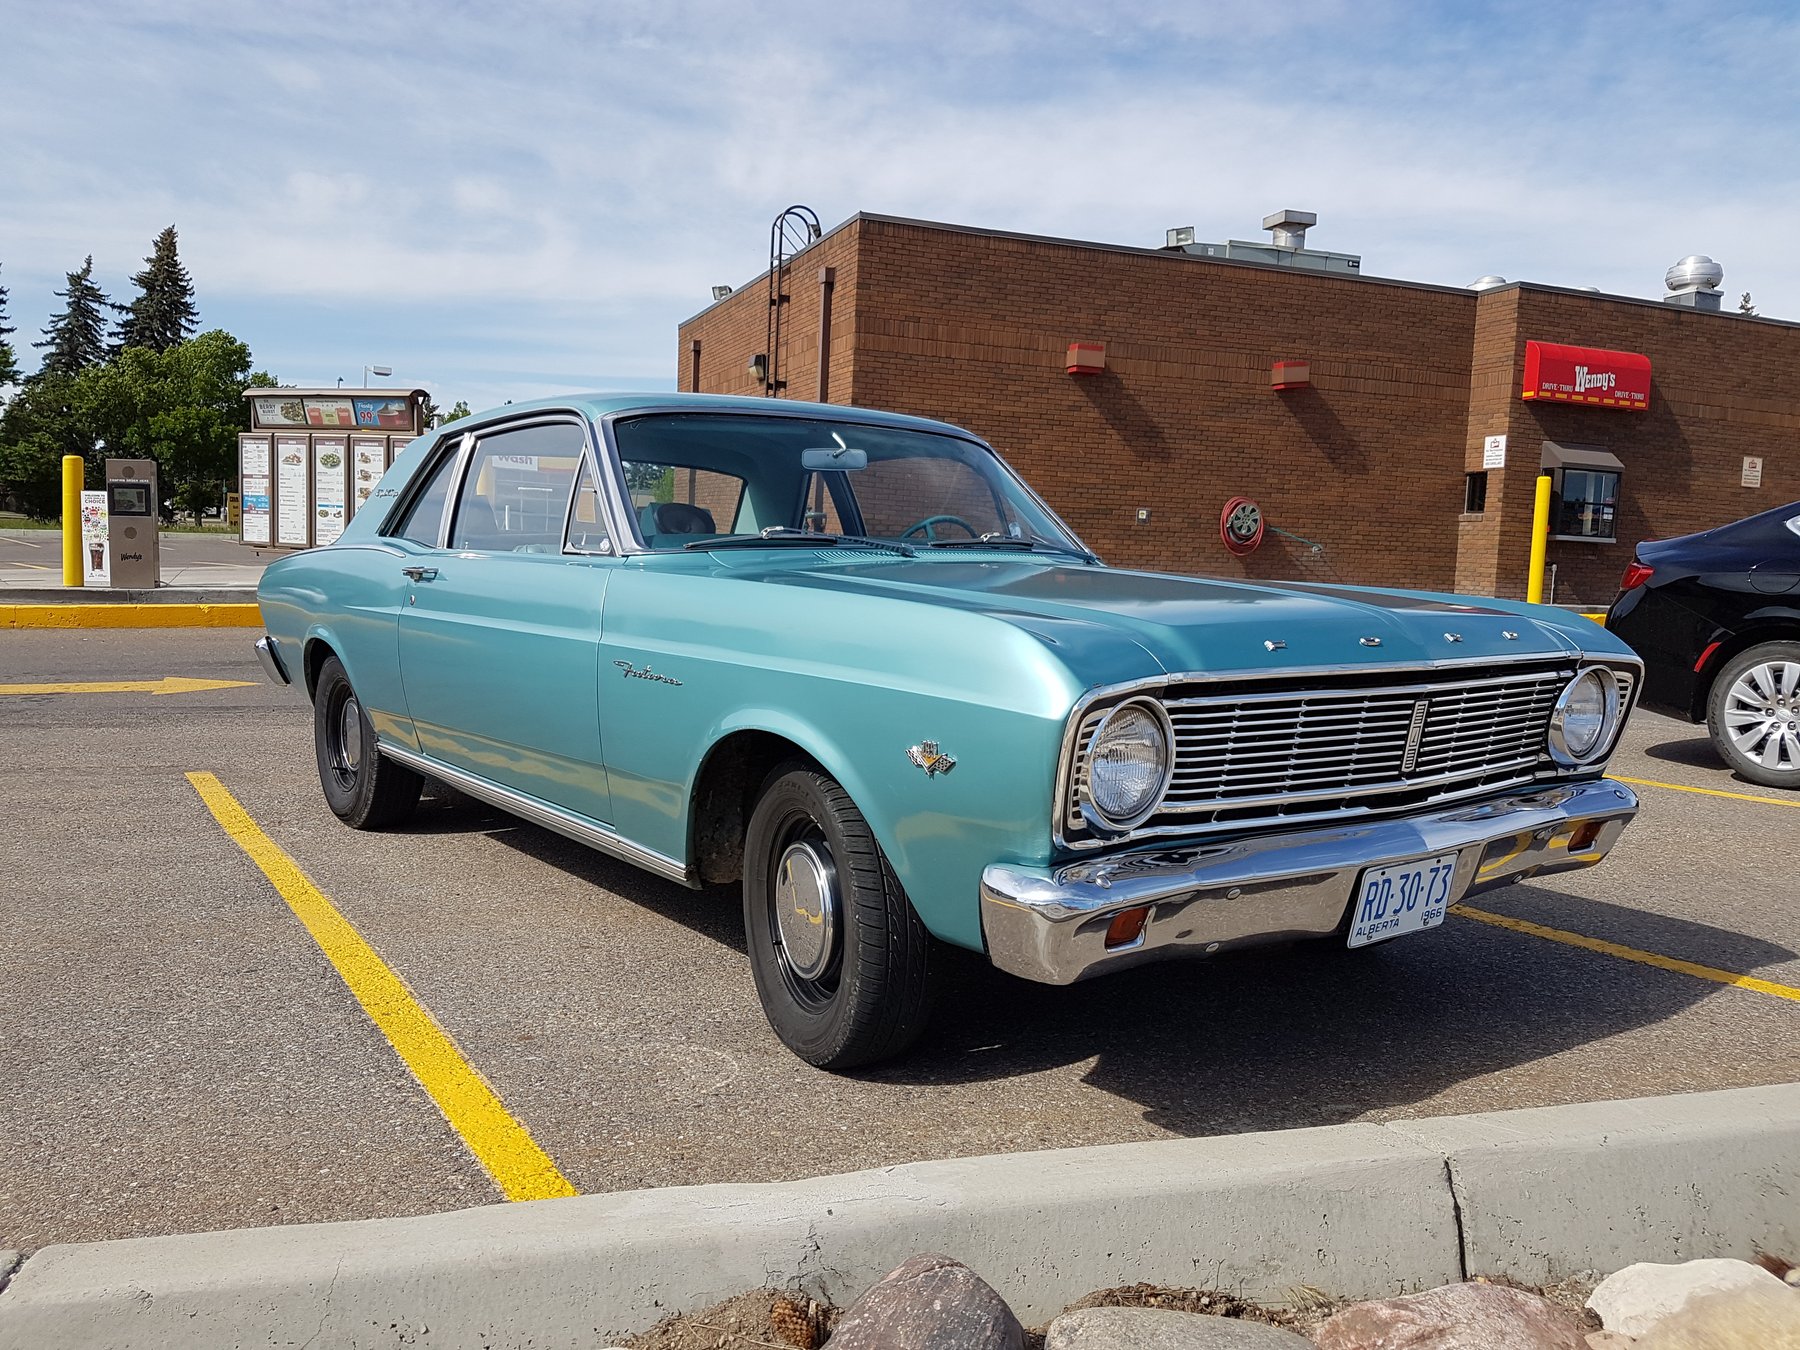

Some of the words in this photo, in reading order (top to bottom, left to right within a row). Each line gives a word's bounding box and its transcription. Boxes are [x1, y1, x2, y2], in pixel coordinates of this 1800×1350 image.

[121, 552, 143, 563] Wendy's
[1355, 918, 1400, 938] ALBERTA
[1420, 907, 1443, 921] 1966
